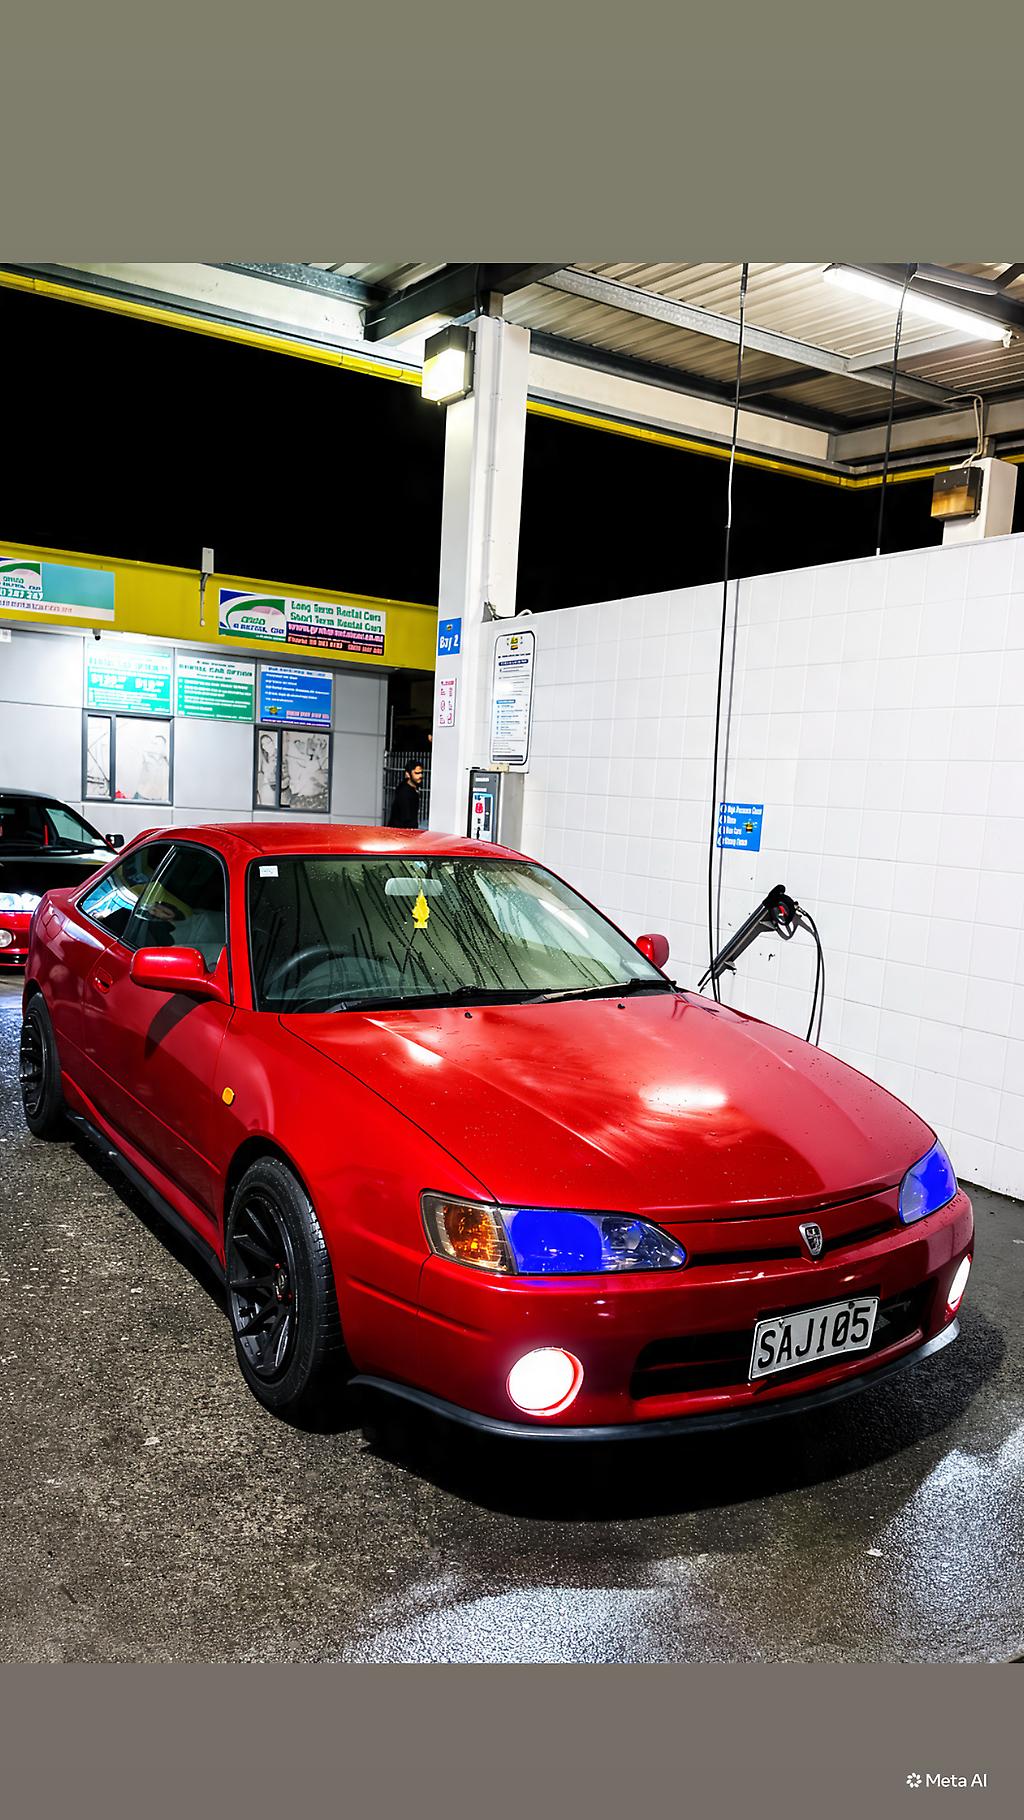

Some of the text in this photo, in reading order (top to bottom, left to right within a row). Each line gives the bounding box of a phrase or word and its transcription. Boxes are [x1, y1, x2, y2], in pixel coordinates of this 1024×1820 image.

[291, 600, 311, 613] Long
[290, 612, 312, 623] Short
[453, 634, 459, 647] 2
[758, 1306, 871, 1369] SAJ105
